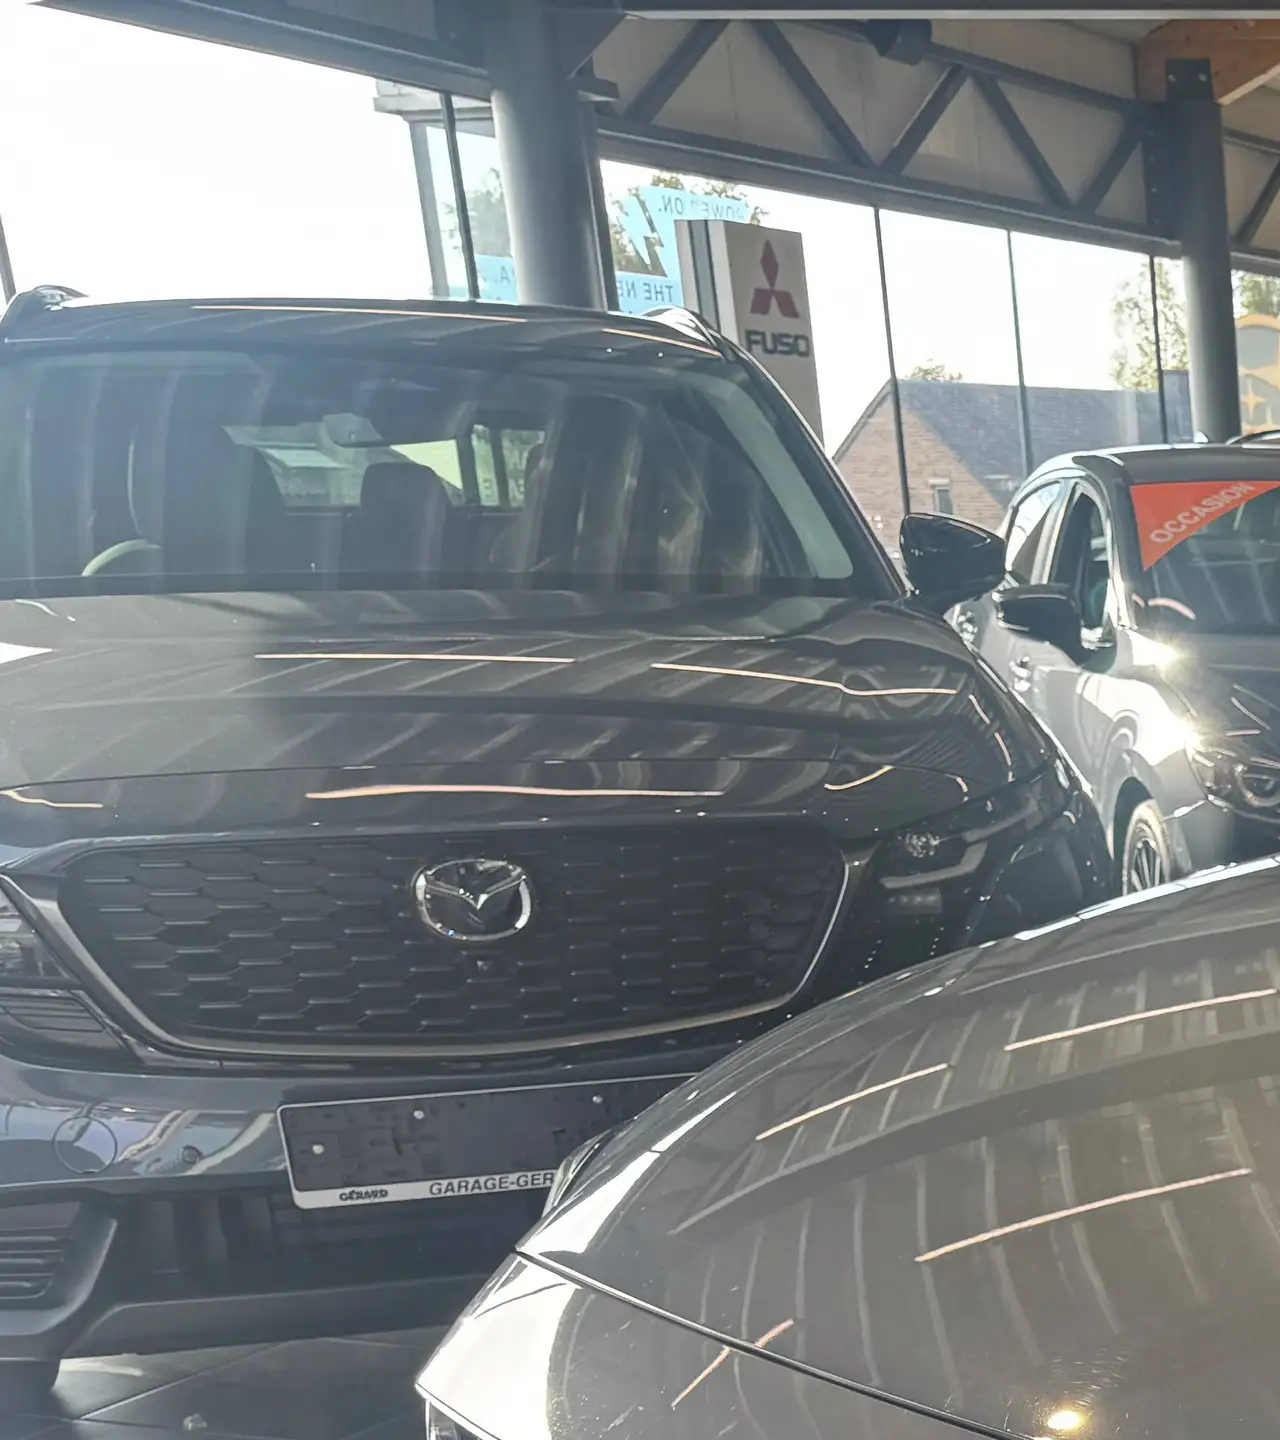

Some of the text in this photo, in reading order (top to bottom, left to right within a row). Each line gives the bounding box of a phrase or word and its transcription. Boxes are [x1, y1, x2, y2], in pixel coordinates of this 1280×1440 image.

[744, 329, 811, 358] FUSO
[1149, 481, 1256, 544] OCCASION
[429, 1171, 555, 1197] GARAGE-GER
